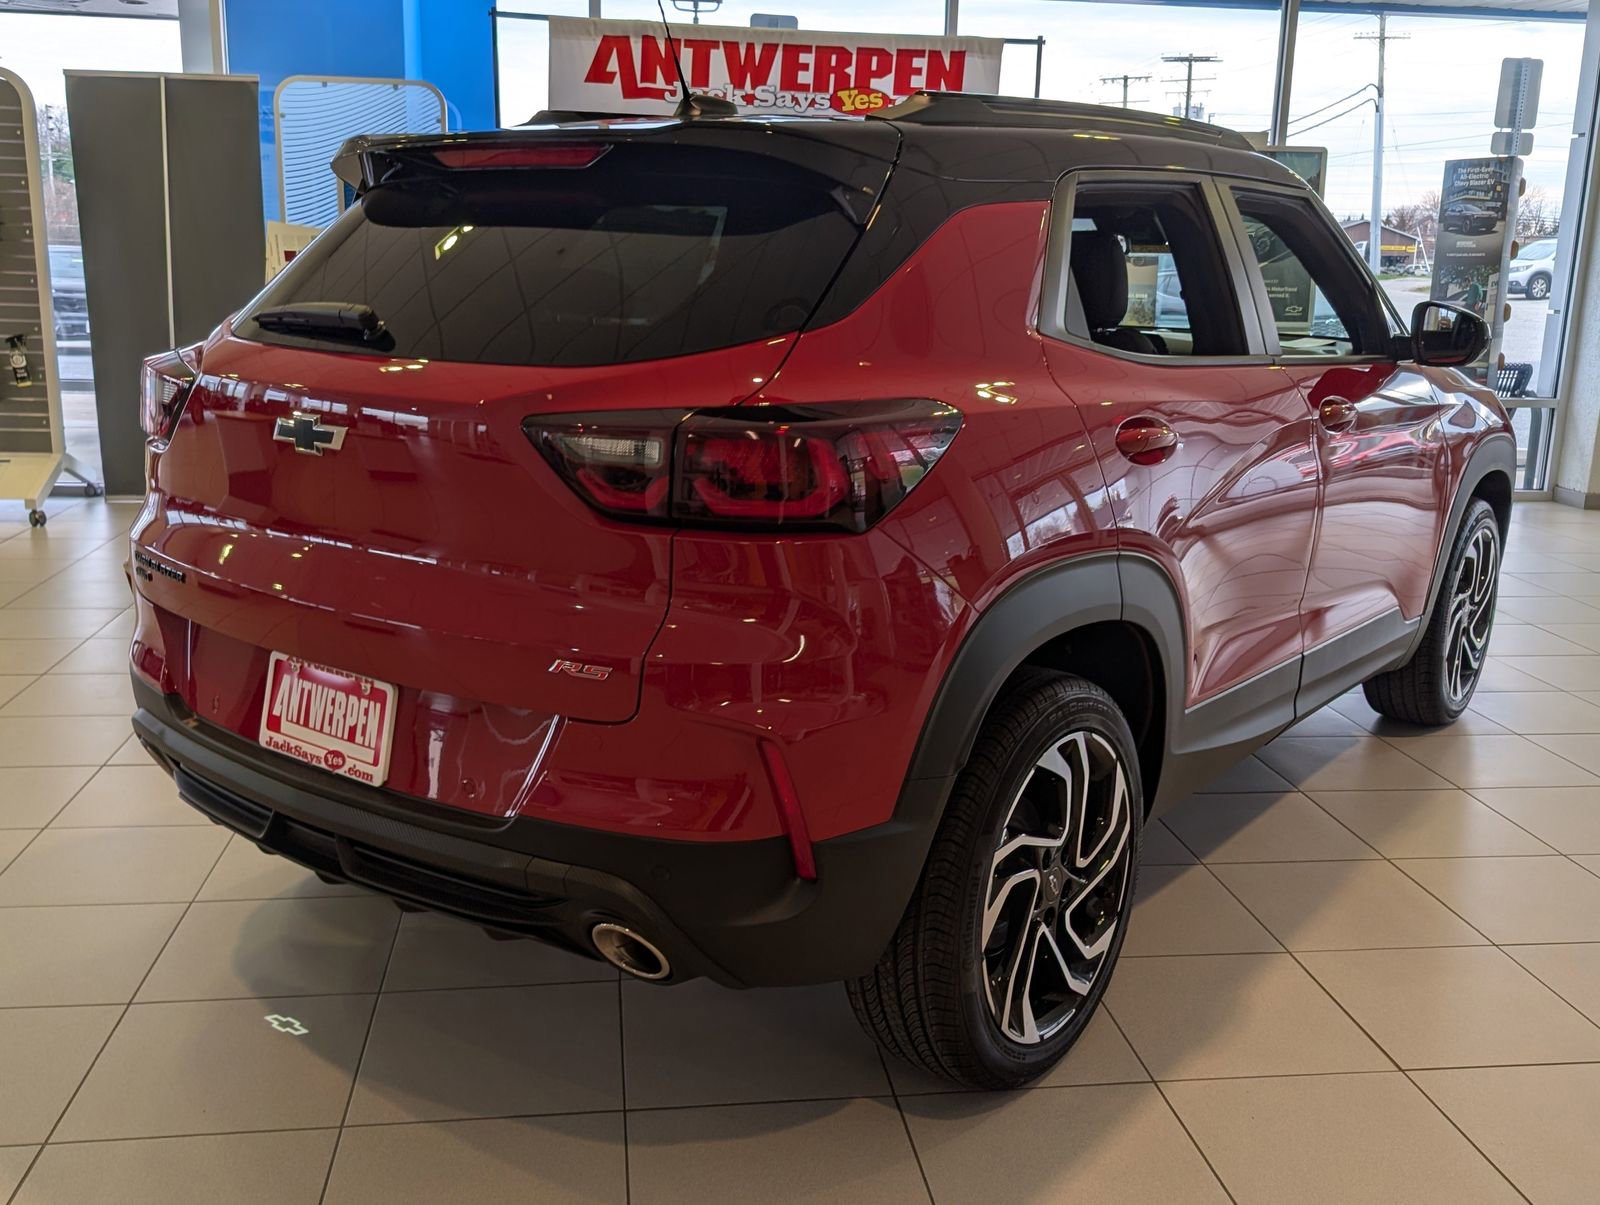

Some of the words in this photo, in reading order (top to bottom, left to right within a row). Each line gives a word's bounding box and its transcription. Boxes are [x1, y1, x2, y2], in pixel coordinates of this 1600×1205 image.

[584, 35, 966, 100] ANTWERPEN
[753, 84, 831, 113] Says
[837, 89, 884, 112] Yes
[548, 659, 613, 681] RS
[272, 674, 381, 750] ANTWERPEN
